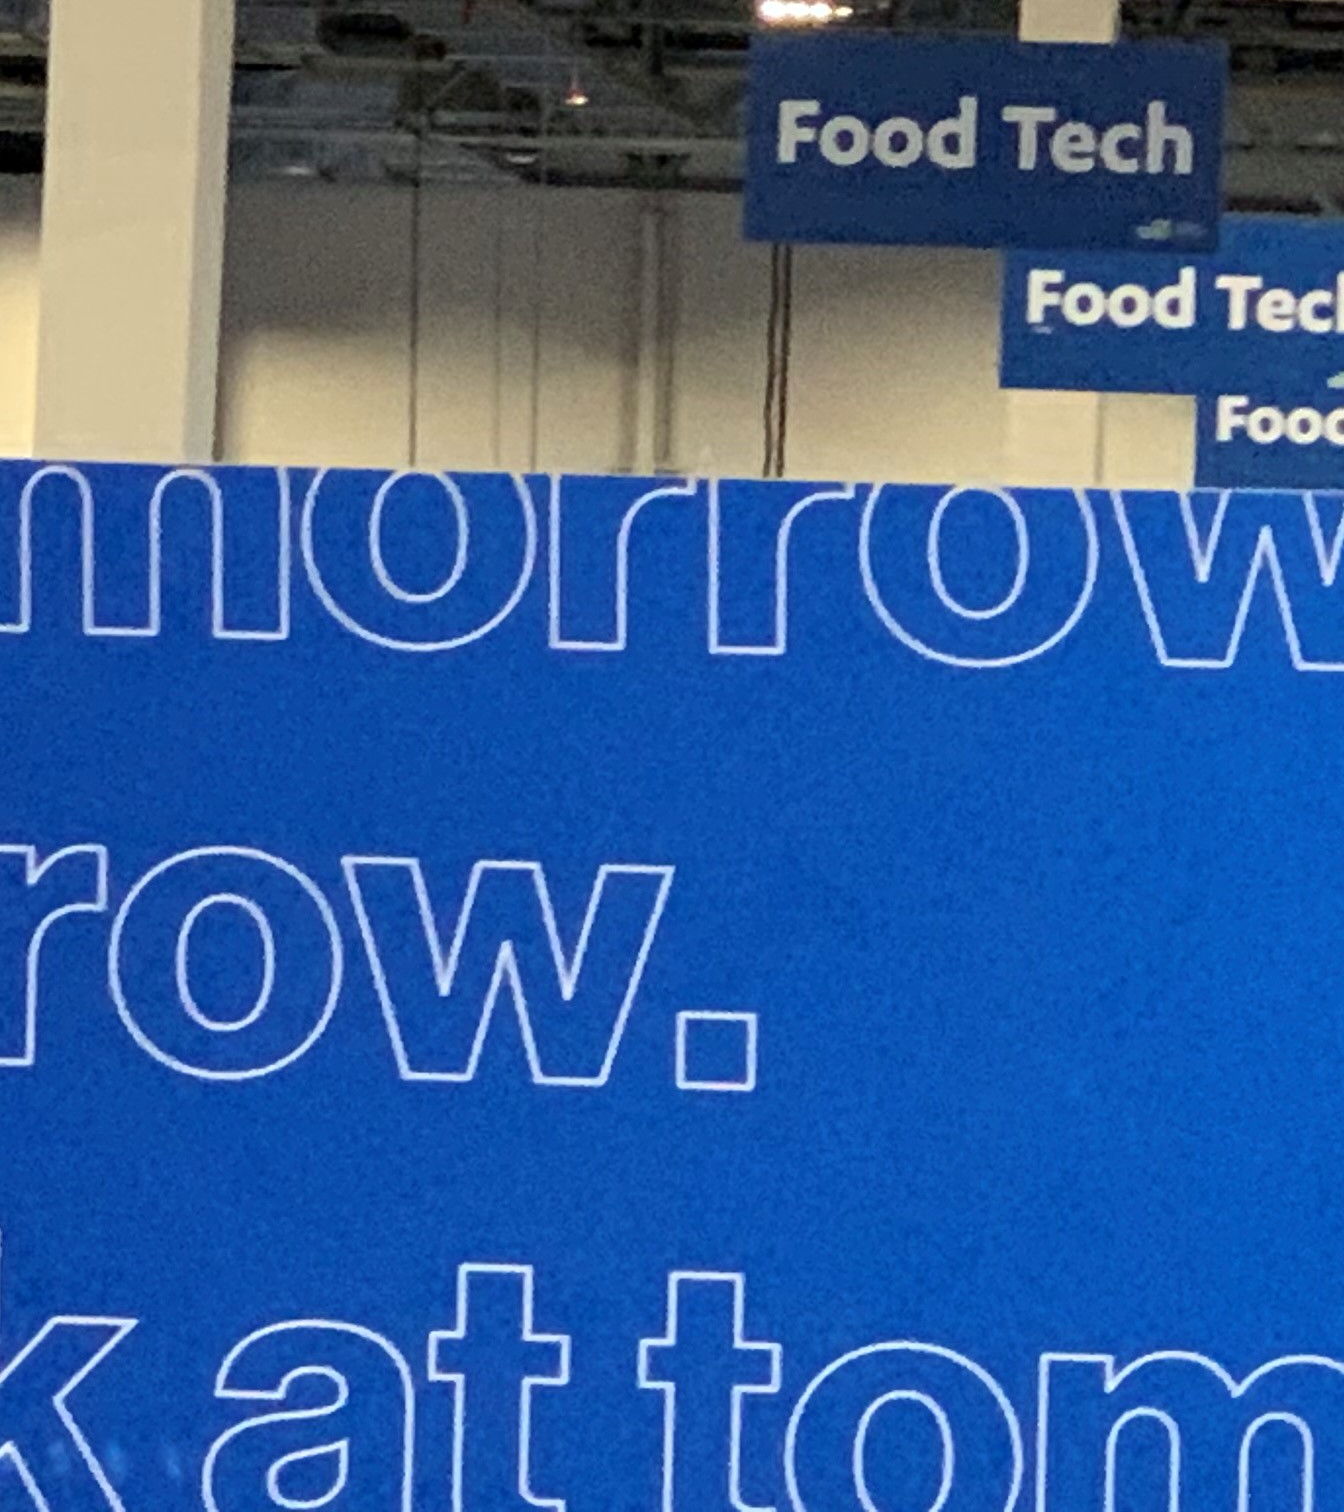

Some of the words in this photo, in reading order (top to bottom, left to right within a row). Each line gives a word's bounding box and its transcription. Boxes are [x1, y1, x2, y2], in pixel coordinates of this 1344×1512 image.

[776, 95, 978, 170] Food
[1001, 100, 1194, 175] Tech
[1026, 266, 1197, 330] Food
[201, 1263, 571, 1512] at
